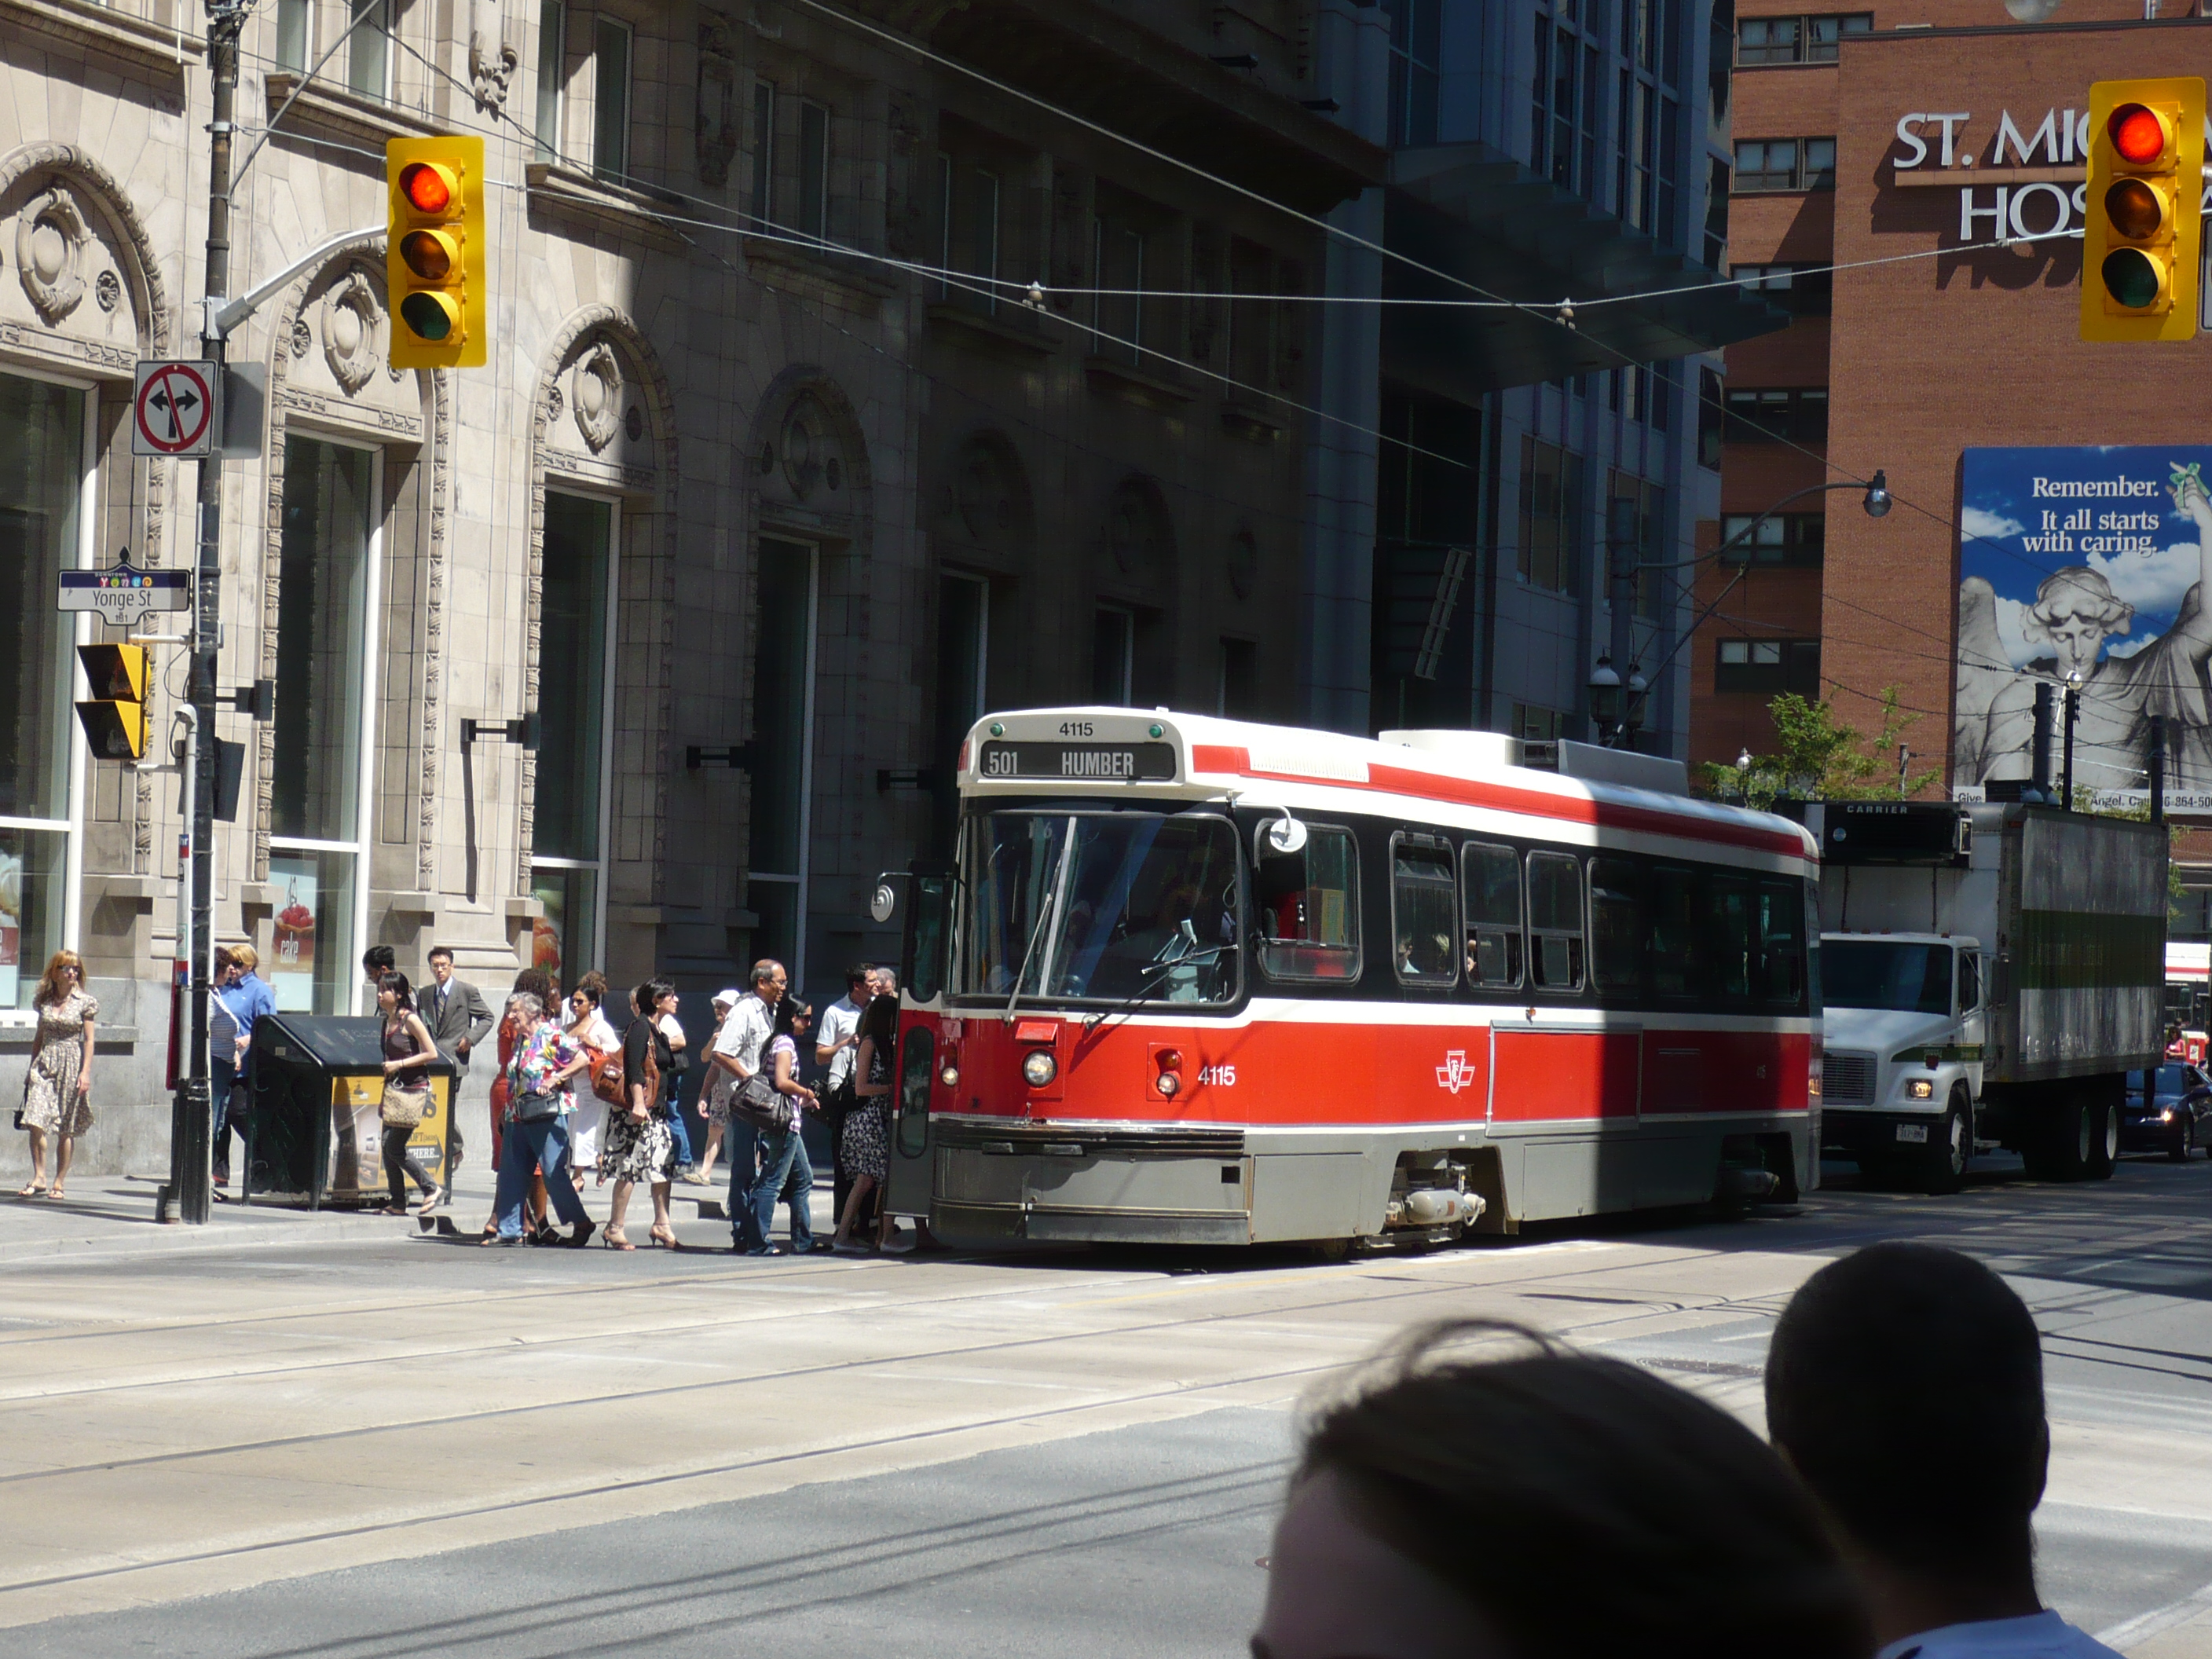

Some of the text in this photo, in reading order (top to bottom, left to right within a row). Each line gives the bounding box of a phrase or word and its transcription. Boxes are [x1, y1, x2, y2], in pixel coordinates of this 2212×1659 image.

[1894, 112, 1972, 168] ST.
[2032, 474, 2159, 497] Remember.
[2041, 508, 2159, 530] It all starts
[2022, 530, 2158, 558] with caring.
[93, 589, 152, 610] Yonge St
[1060, 722, 1093, 736] 4115
[989, 751, 1133, 776] 501 HUMBER
[1958, 792, 1983, 803] Give
[1847, 805, 1907, 814] CARRIER
[280, 931, 298, 964] cake
[1197, 1065, 1236, 1086] 4115
